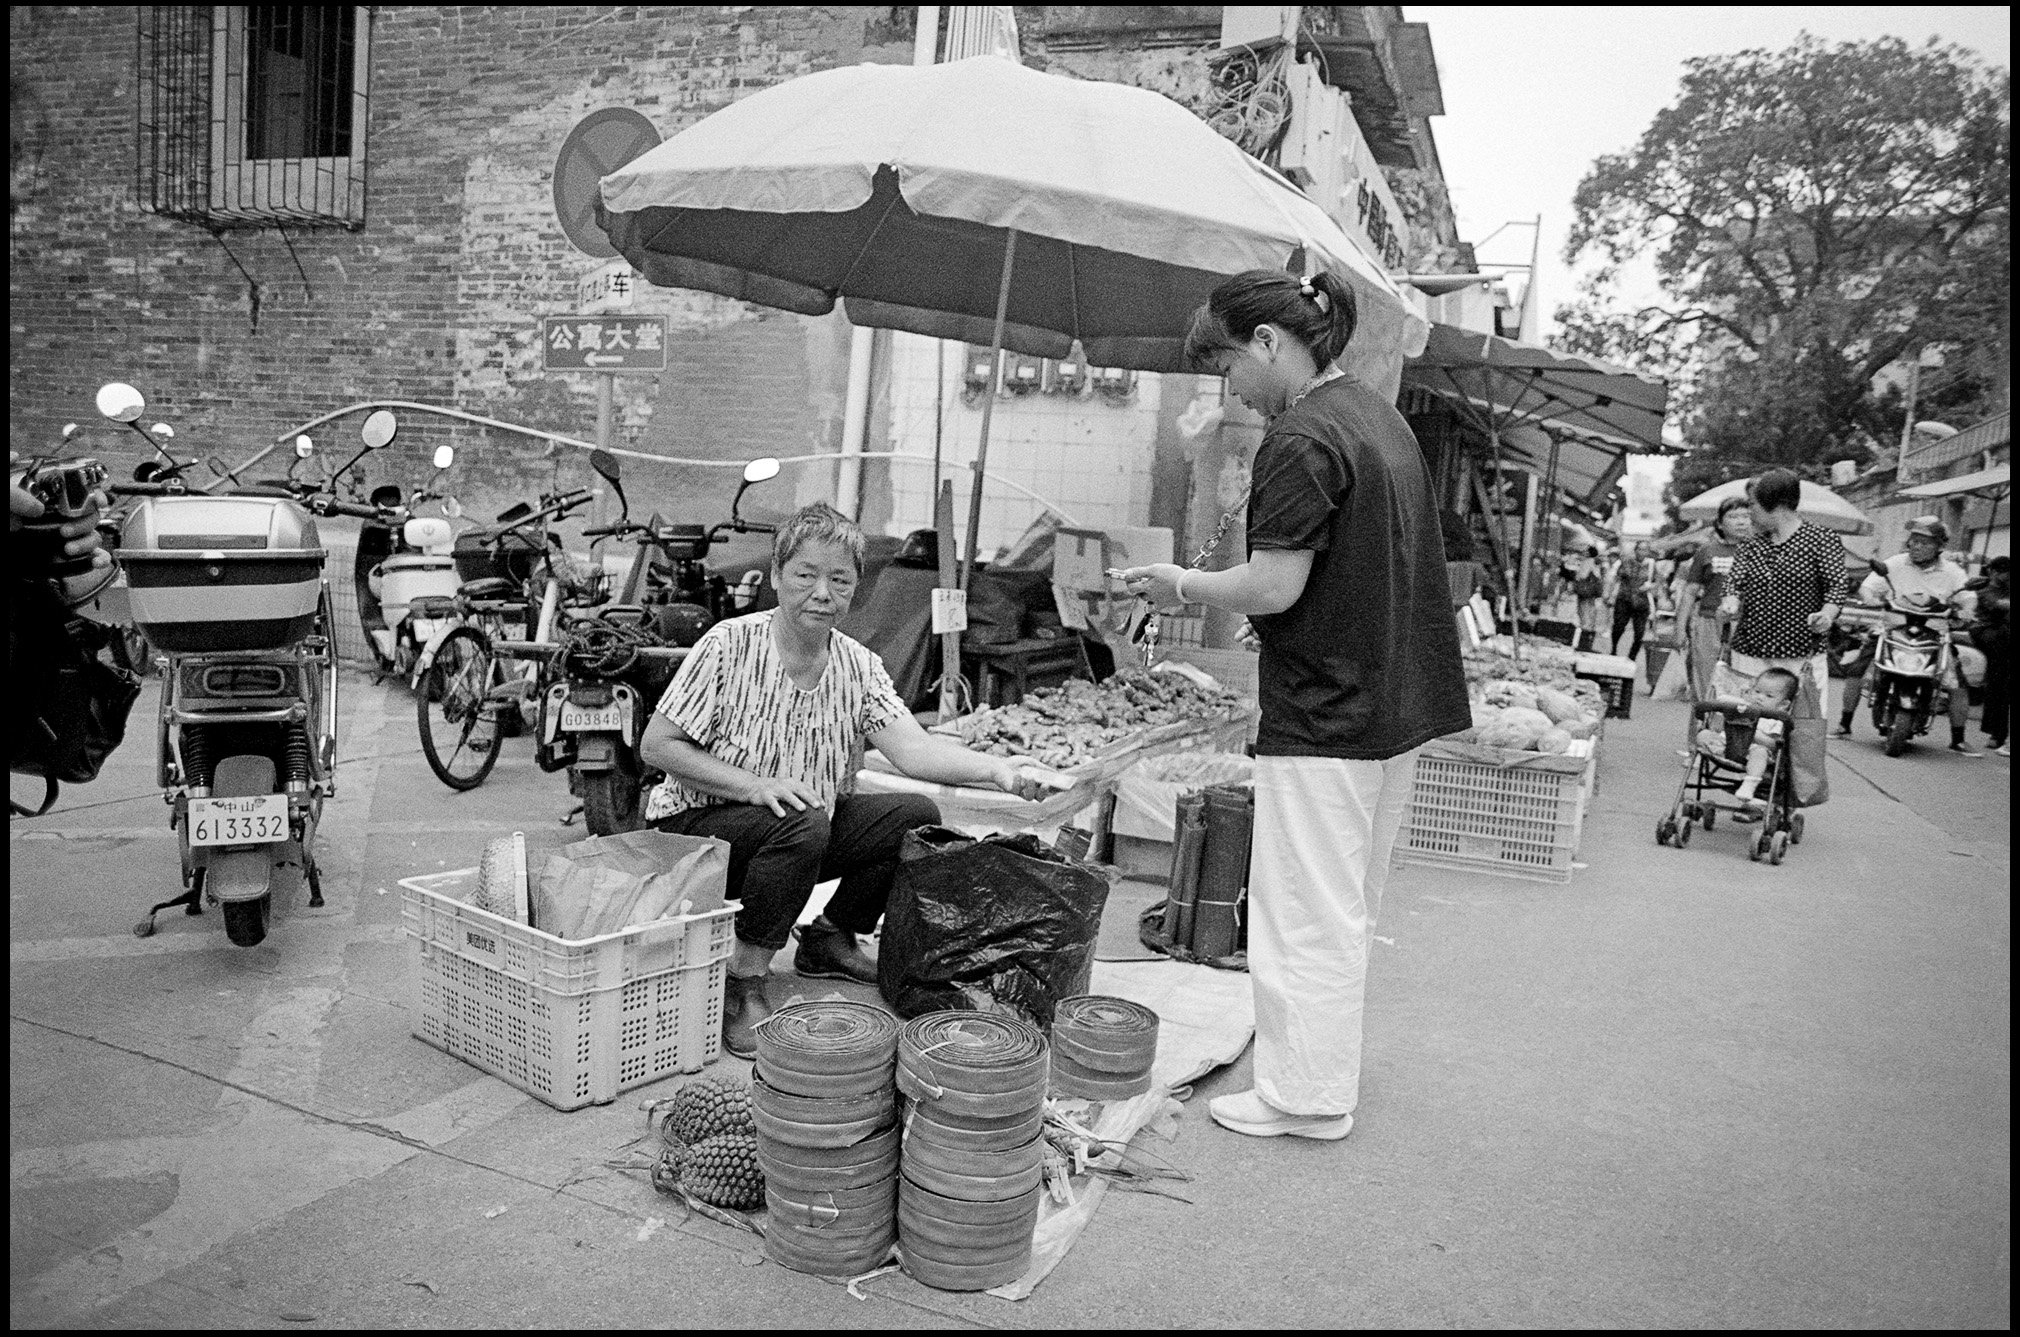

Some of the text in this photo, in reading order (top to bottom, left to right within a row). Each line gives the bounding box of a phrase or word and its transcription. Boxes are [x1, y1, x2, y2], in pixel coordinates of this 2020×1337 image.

[549, 322, 662, 351] 公寓大堂
[224, 801, 255, 813] 中山
[196, 815, 282, 840] 613332
